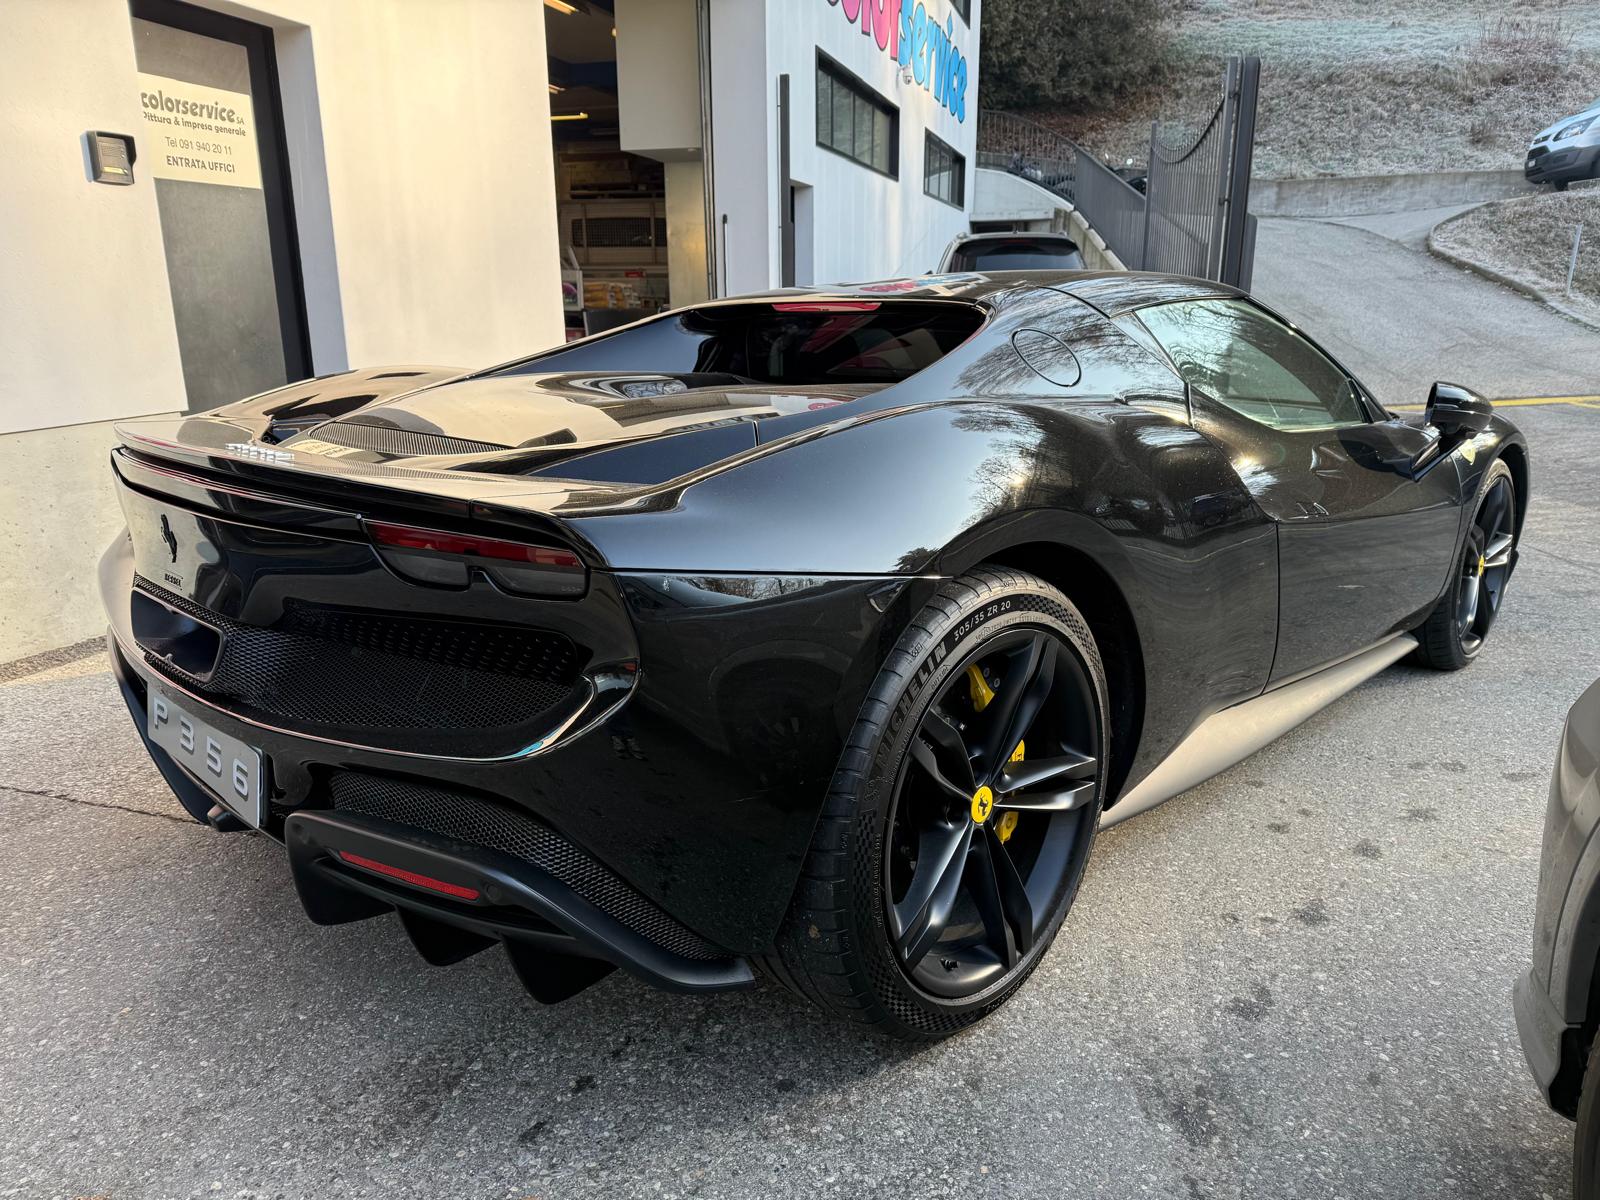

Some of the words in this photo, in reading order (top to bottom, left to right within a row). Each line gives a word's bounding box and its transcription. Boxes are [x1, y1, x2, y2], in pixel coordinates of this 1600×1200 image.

[140, 90, 236, 123] colorservice
[236, 116, 245, 125] SA
[173, 116, 180, 126] &
[181, 118, 213, 132] impresa
[214, 123, 246, 137] generale
[166, 137, 178, 148] Tel
[179, 138, 194, 150] 091
[195, 140, 210, 152] 940
[212, 143, 222, 154] 20
[224, 145, 232, 155] 11
[166, 155, 208, 170] ENTRATA
[208, 160, 235, 173] UFFICI
[954, 611, 984, 641] 305/35
[987, 605, 998, 617] ZR
[1001, 600, 1011, 611] 20
